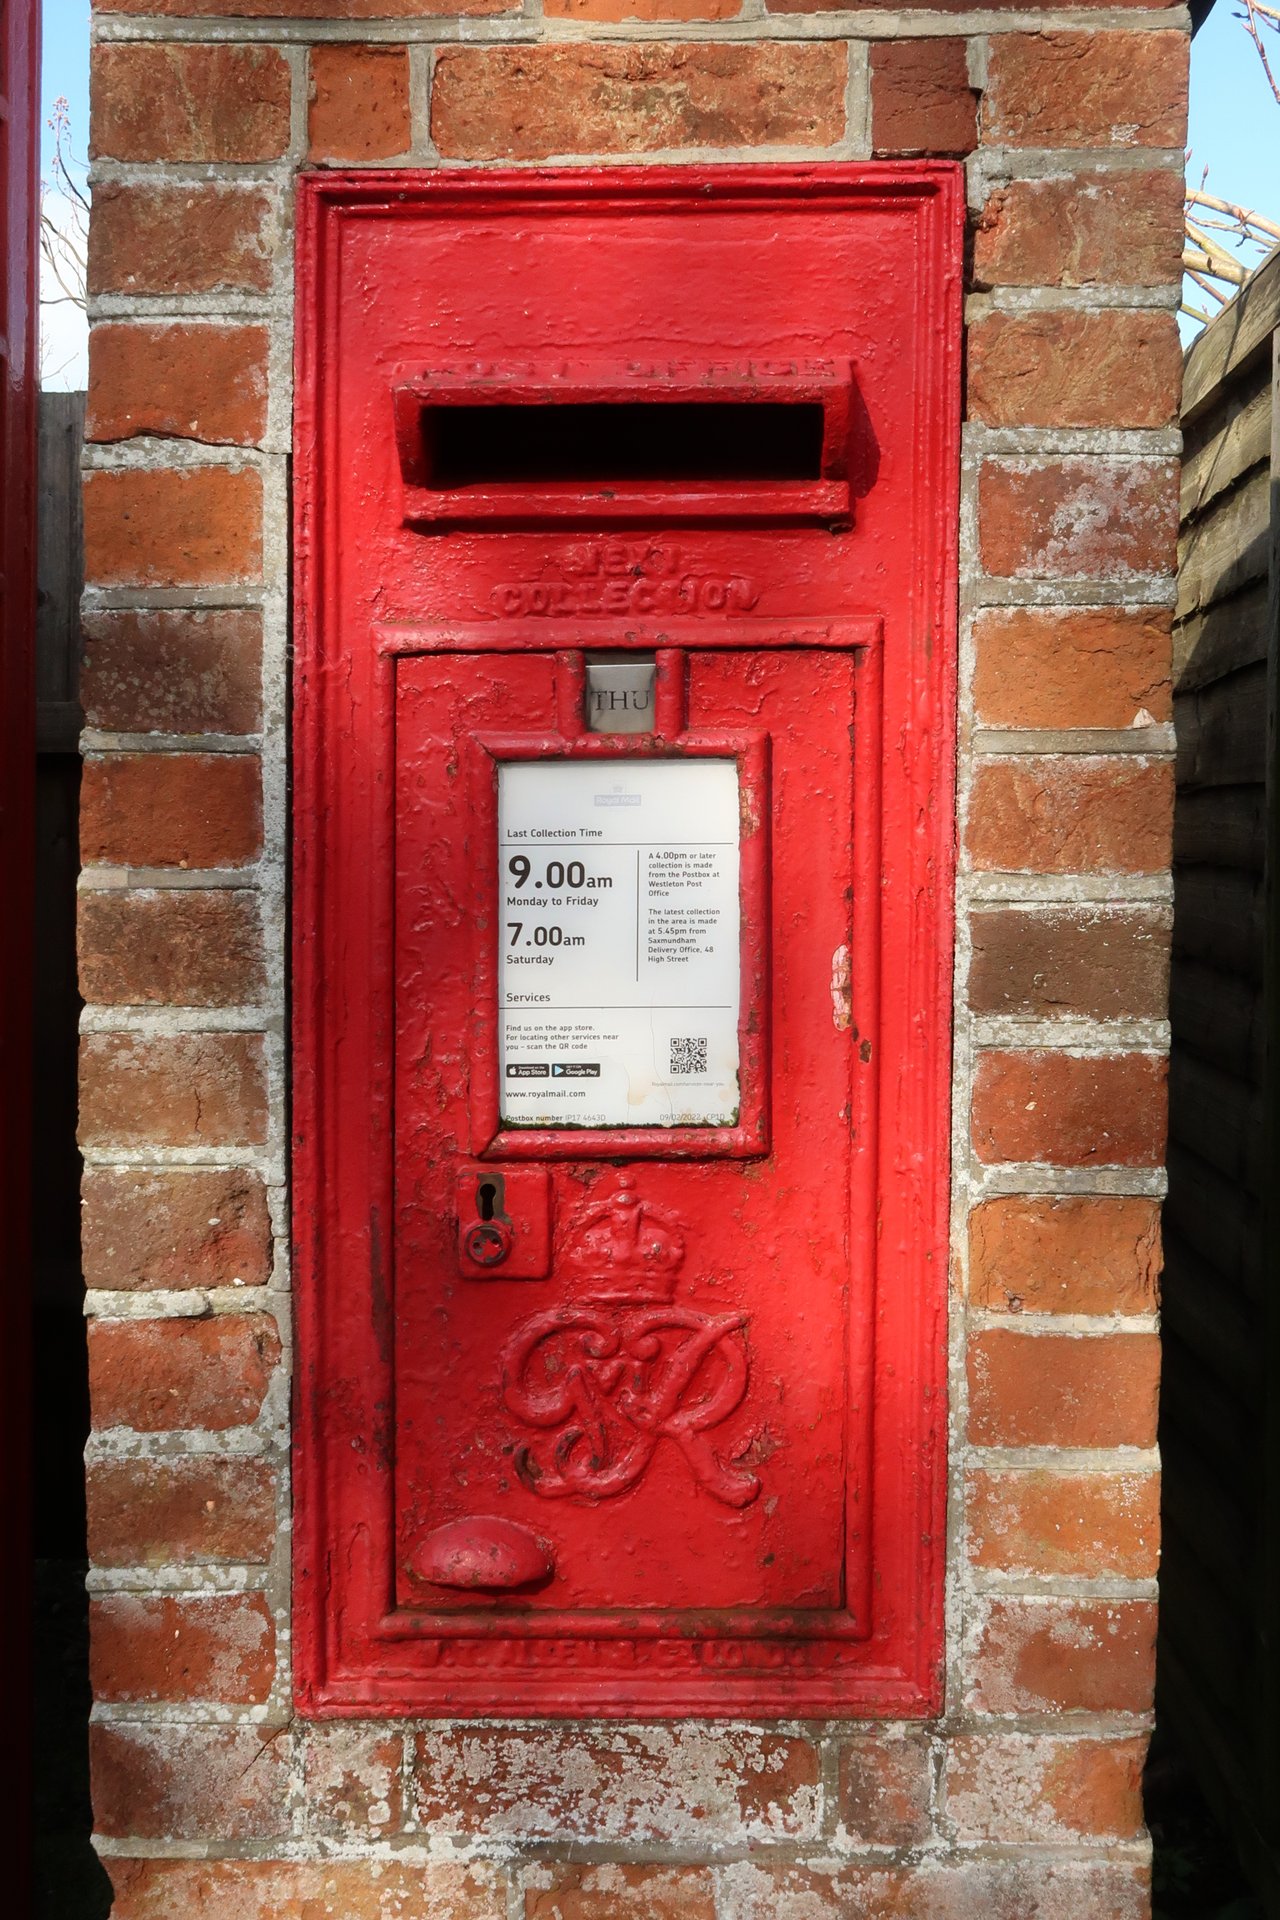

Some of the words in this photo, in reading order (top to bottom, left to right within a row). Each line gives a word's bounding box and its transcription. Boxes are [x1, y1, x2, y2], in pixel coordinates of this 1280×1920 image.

[566, 542, 681, 577] NEXT
[497, 578, 760, 617] COLLECTION
[590, 690, 651, 711] THU
[507, 829, 527, 838] Last
[530, 828, 576, 838] Collection
[579, 828, 603, 837] Time
[656, 851, 687, 860] 4.00pm
[508, 855, 613, 889] 9.00am
[507, 896, 548, 907] Monday
[552, 897, 562, 906] to
[566, 896, 599, 907] Friday
[507, 922, 585, 946] 7.00am
[658, 927, 687, 935] 5.45pm
[648, 946, 677, 954] Delivery
[506, 955, 554, 965] Saturday
[506, 992, 551, 1002] Services
[506, 1090, 586, 1098] www.royalmail.com
